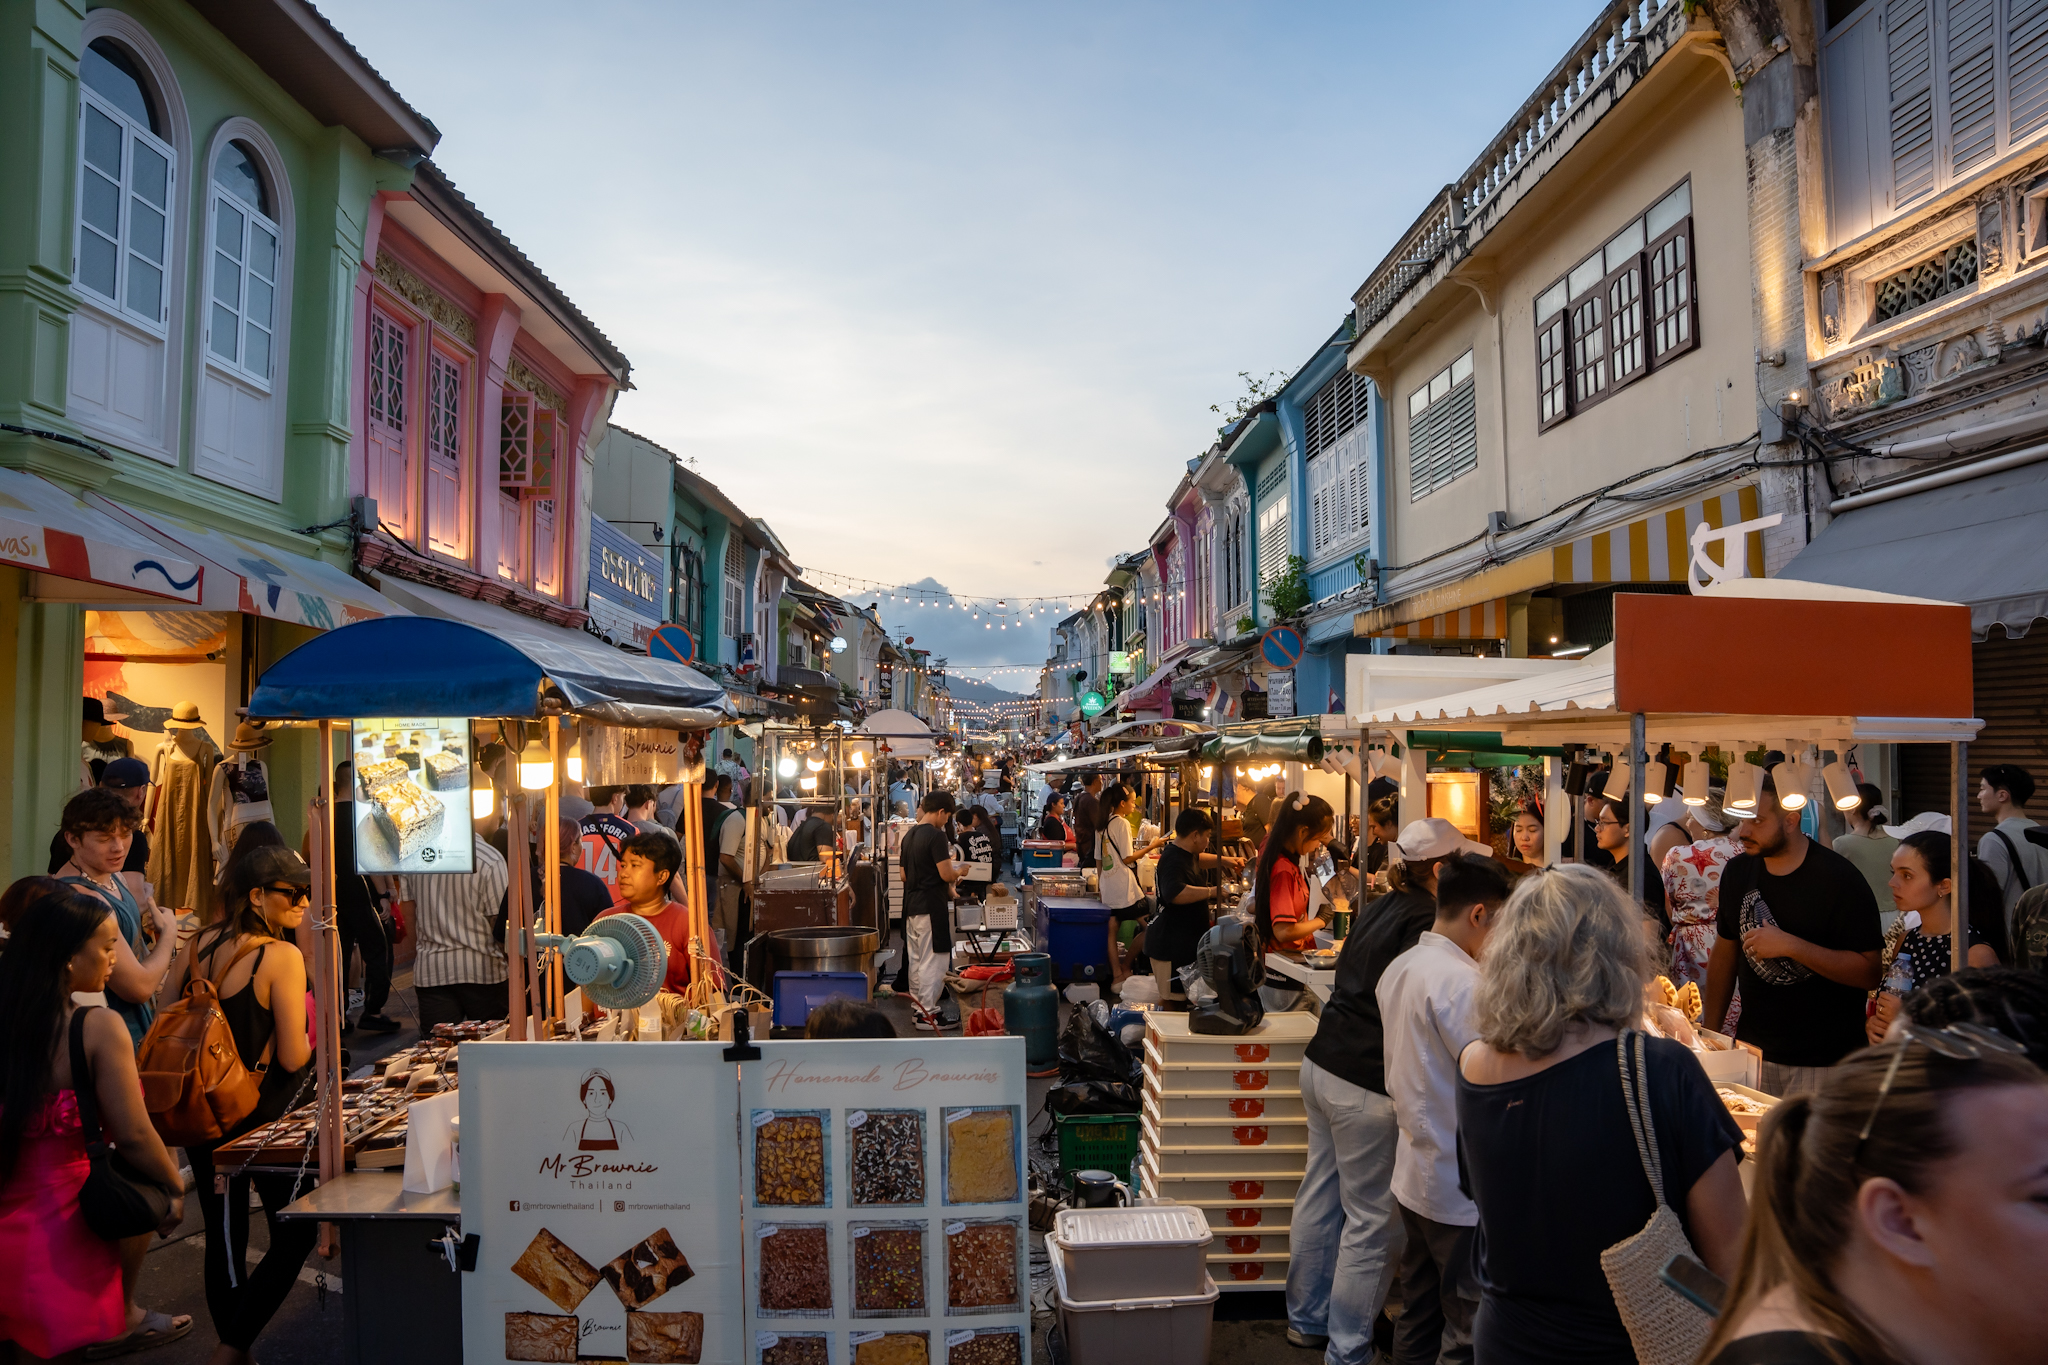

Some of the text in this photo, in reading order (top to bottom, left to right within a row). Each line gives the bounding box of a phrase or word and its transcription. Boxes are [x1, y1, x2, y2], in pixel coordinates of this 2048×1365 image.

[1437, 588, 1461, 608] SUNSHINE
[623, 736, 676, 759] Brownie
[582, 841, 618, 885] 14
[765, 1057, 1001, 1093] Homemade Brownies
[849, 1113, 865, 1125] Oreo
[539, 1153, 659, 1179] Mr Brownie
[570, 1180, 632, 1190] Thailand
[522, 1202, 691, 1211] @mrbrowniethailand mrbrowniethailand
[757, 1228, 776, 1236] Original
[582, 1318, 622, 1337] Brownie
